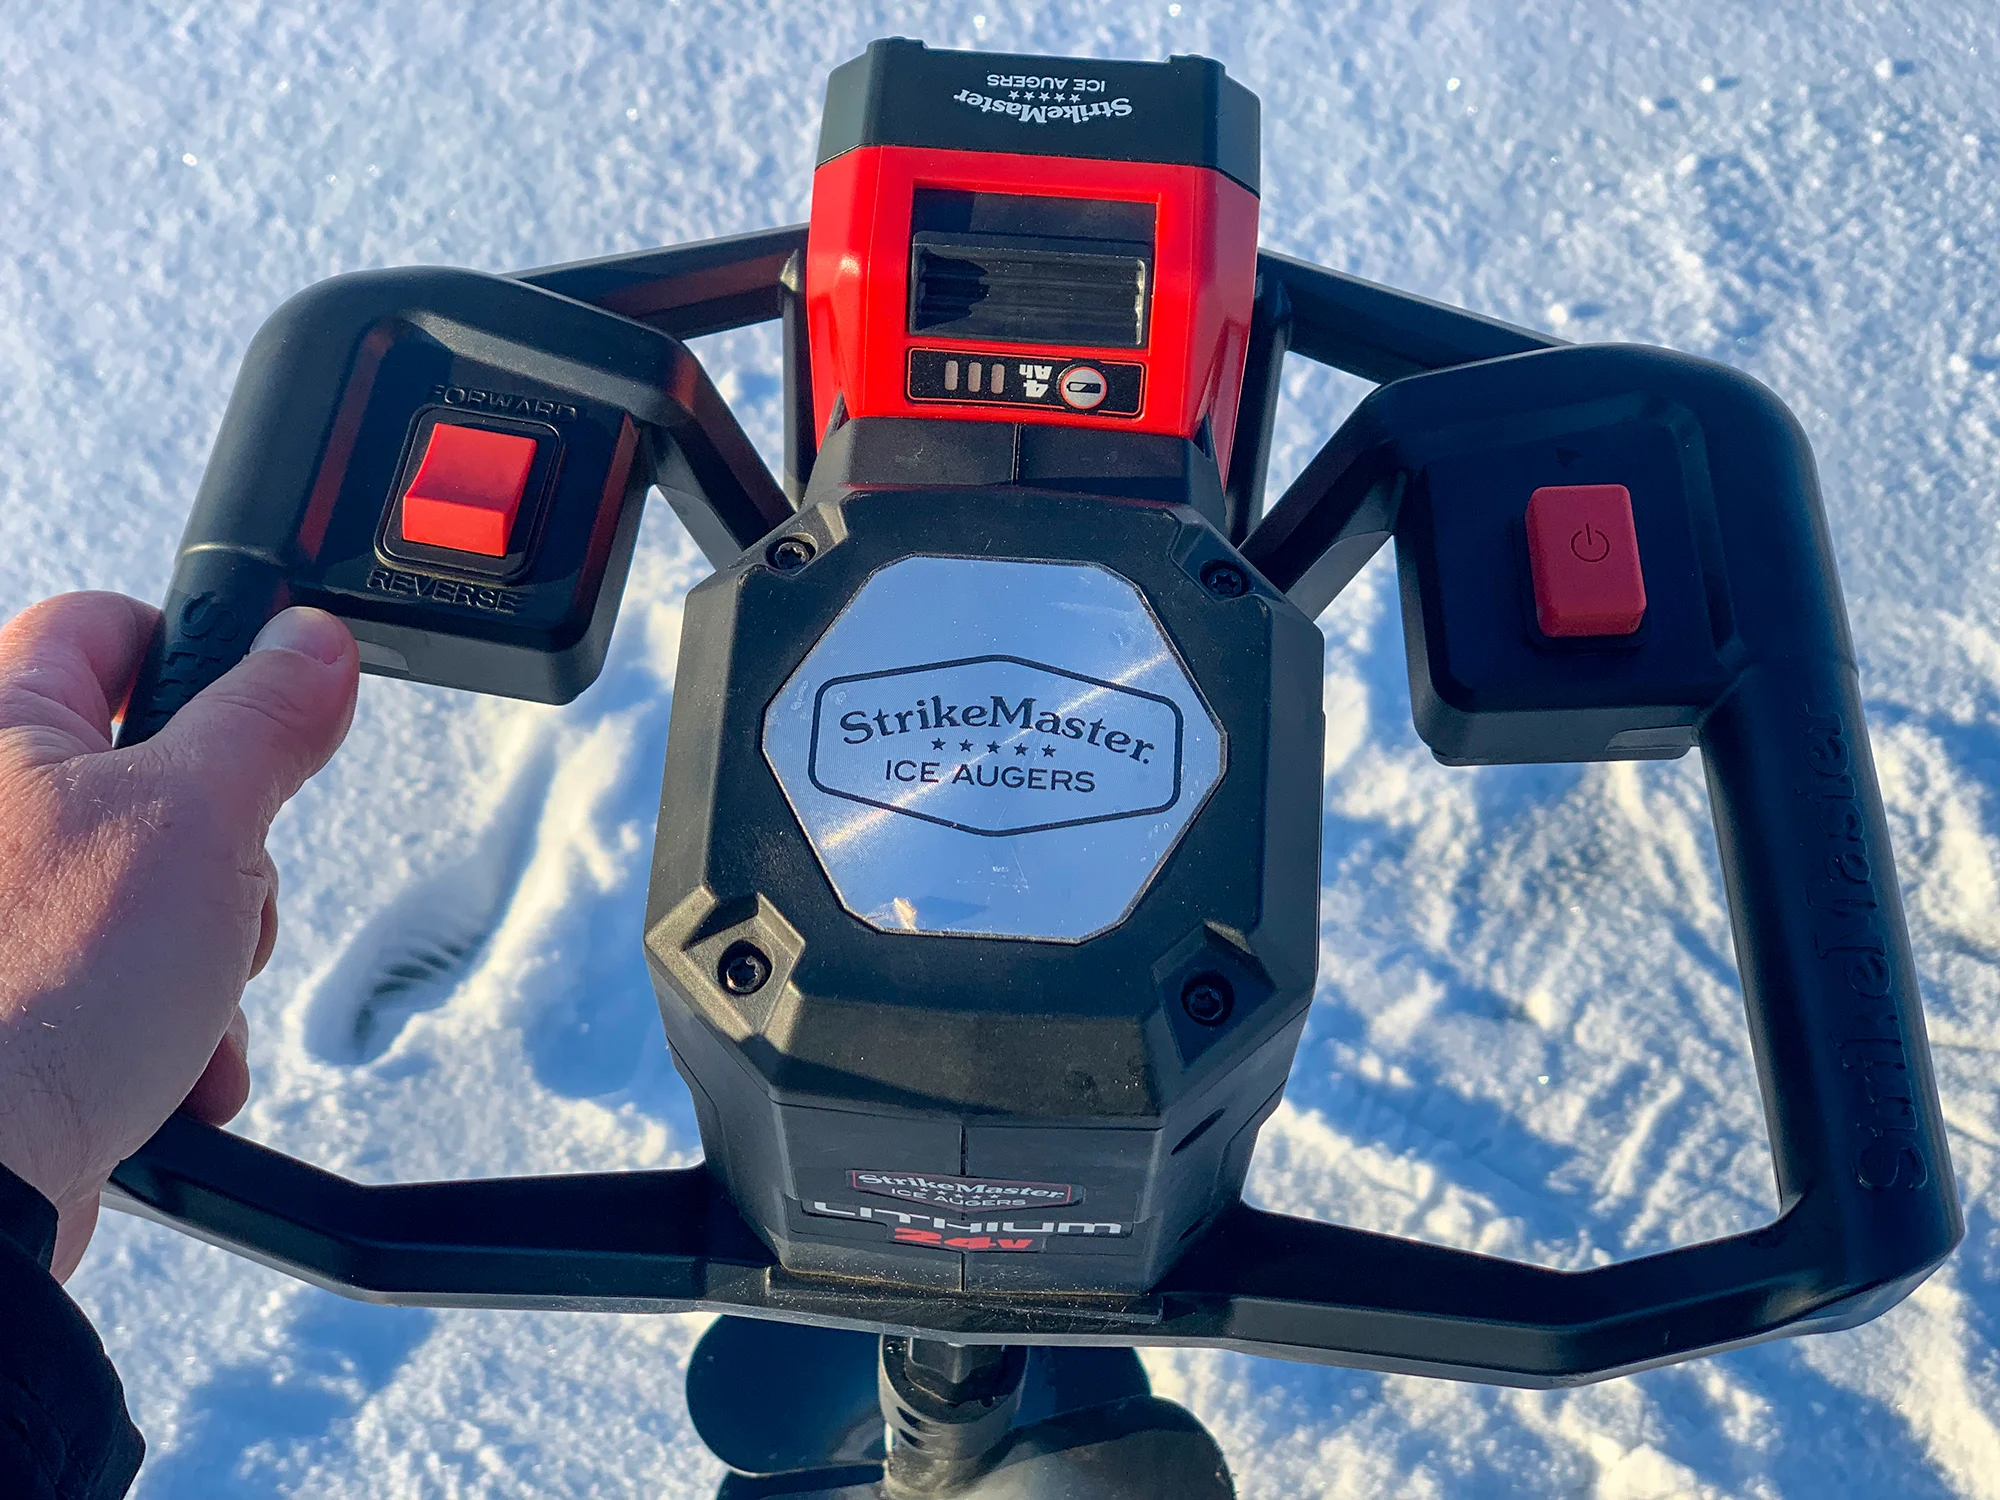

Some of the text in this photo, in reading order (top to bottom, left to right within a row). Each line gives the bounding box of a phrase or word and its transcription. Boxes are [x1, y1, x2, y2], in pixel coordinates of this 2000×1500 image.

[986, 74, 1106, 92] ICE AUGERS
[953, 89, 1133, 123] StrikeMaster
[1019, 364, 1053, 380] Ah
[428, 383, 578, 420] FORWARD
[1023, 380, 1049, 398] 4
[366, 568, 524, 615] REVERSE
[885, 760, 1096, 793] ICE AUGERS
[1797, 702, 1928, 1190] StrikeMaster
[891, 1187, 1027, 1207] ICE AUGERS
[813, 1200, 1122, 1235] LITHIUM
